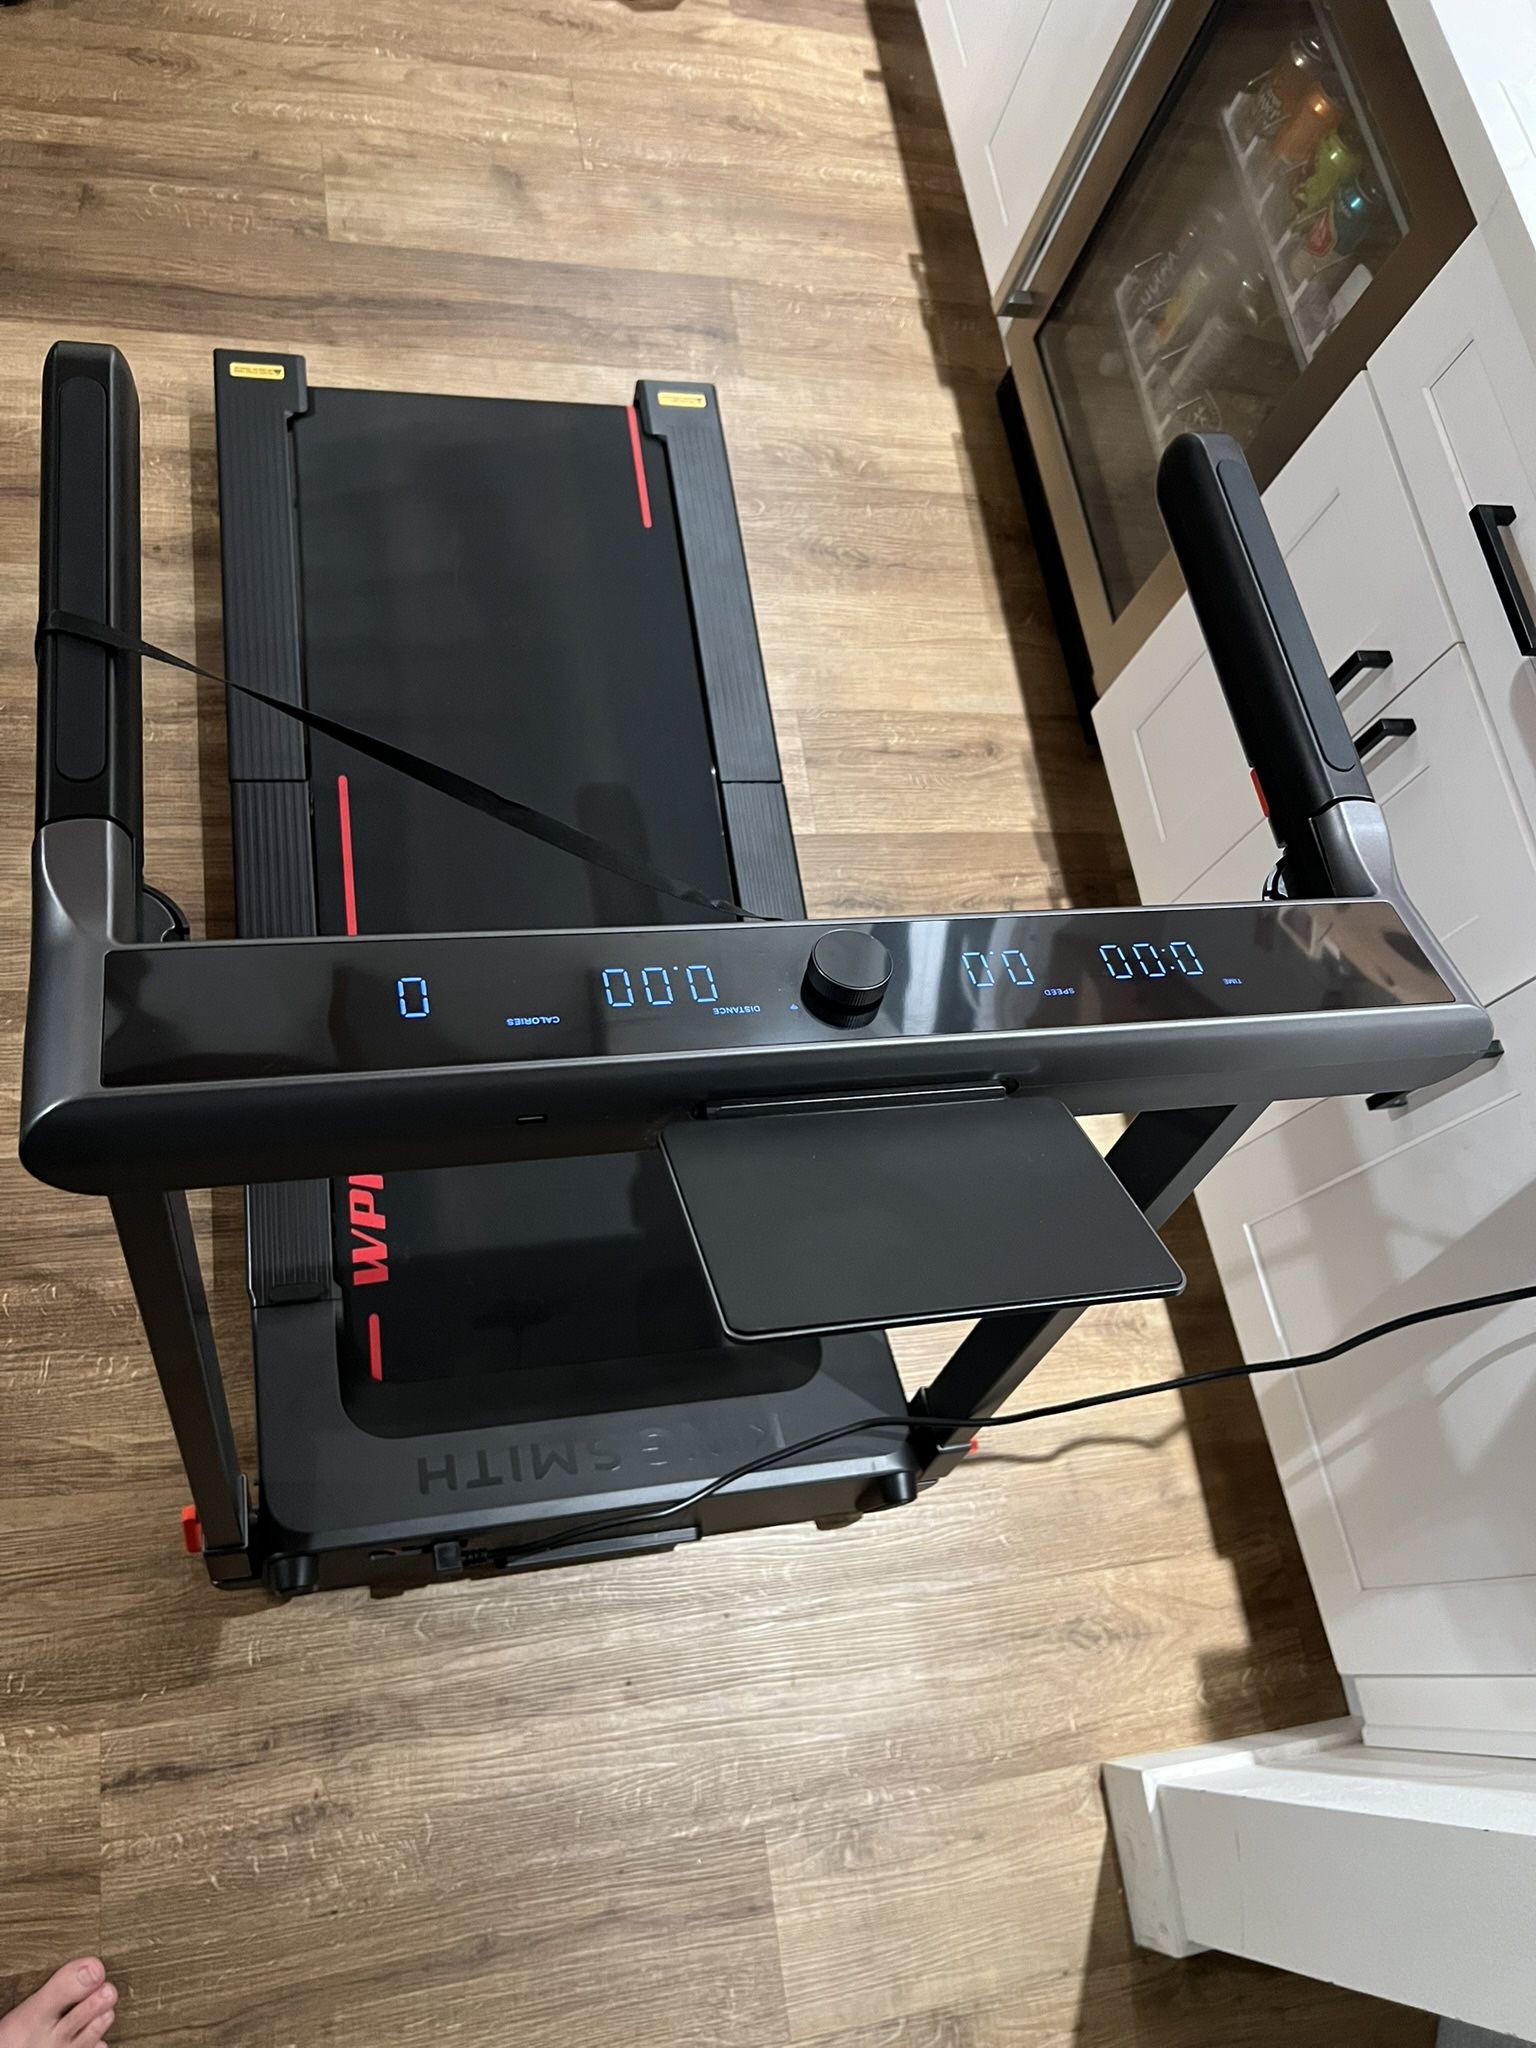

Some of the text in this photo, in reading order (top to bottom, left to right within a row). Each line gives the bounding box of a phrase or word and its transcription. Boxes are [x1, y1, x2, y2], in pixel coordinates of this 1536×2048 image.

[1099, 942, 1204, 979] 0:00
[397, 976, 430, 1018] 0
[1043, 987, 1075, 996] SPEED
[506, 1015, 560, 1026] CALORIES
[712, 1005, 761, 1015] DISTANCE
[417, 1412, 788, 1494] KGSMITH
